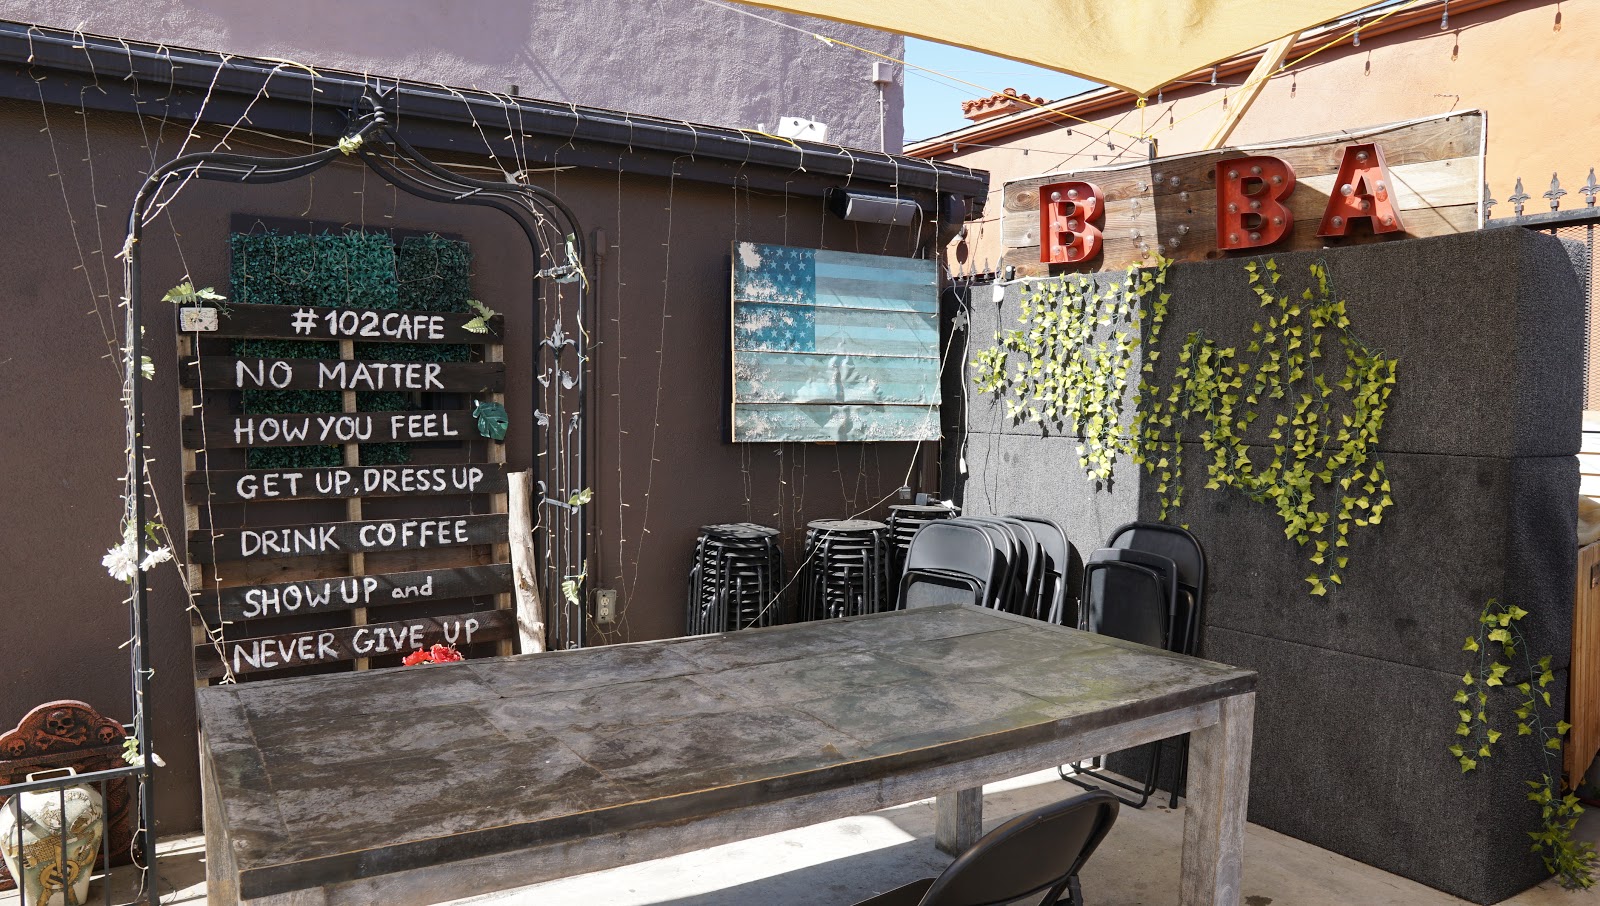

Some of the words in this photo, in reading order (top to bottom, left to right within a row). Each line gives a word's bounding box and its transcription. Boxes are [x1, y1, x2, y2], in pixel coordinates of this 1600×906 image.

[290, 307, 445, 341] #102CAFE
[235, 359, 293, 389] NO
[318, 361, 445, 391] MATTER
[233, 417, 310, 445] HOW
[316, 415, 372, 442] YOU
[390, 412, 459, 440] FEEL
[236, 472, 304, 500] GET
[452, 466, 484, 492] UP
[241, 525, 341, 557] DRINK
[359, 520, 469, 548] COFFEE
[242, 583, 331, 618] SHOW
[340, 577, 378, 604] UP
[391, 575, 433, 599] and
[233, 632, 339, 674] NEVER
[352, 624, 424, 654] GIVE
[442, 617, 480, 646] UP
